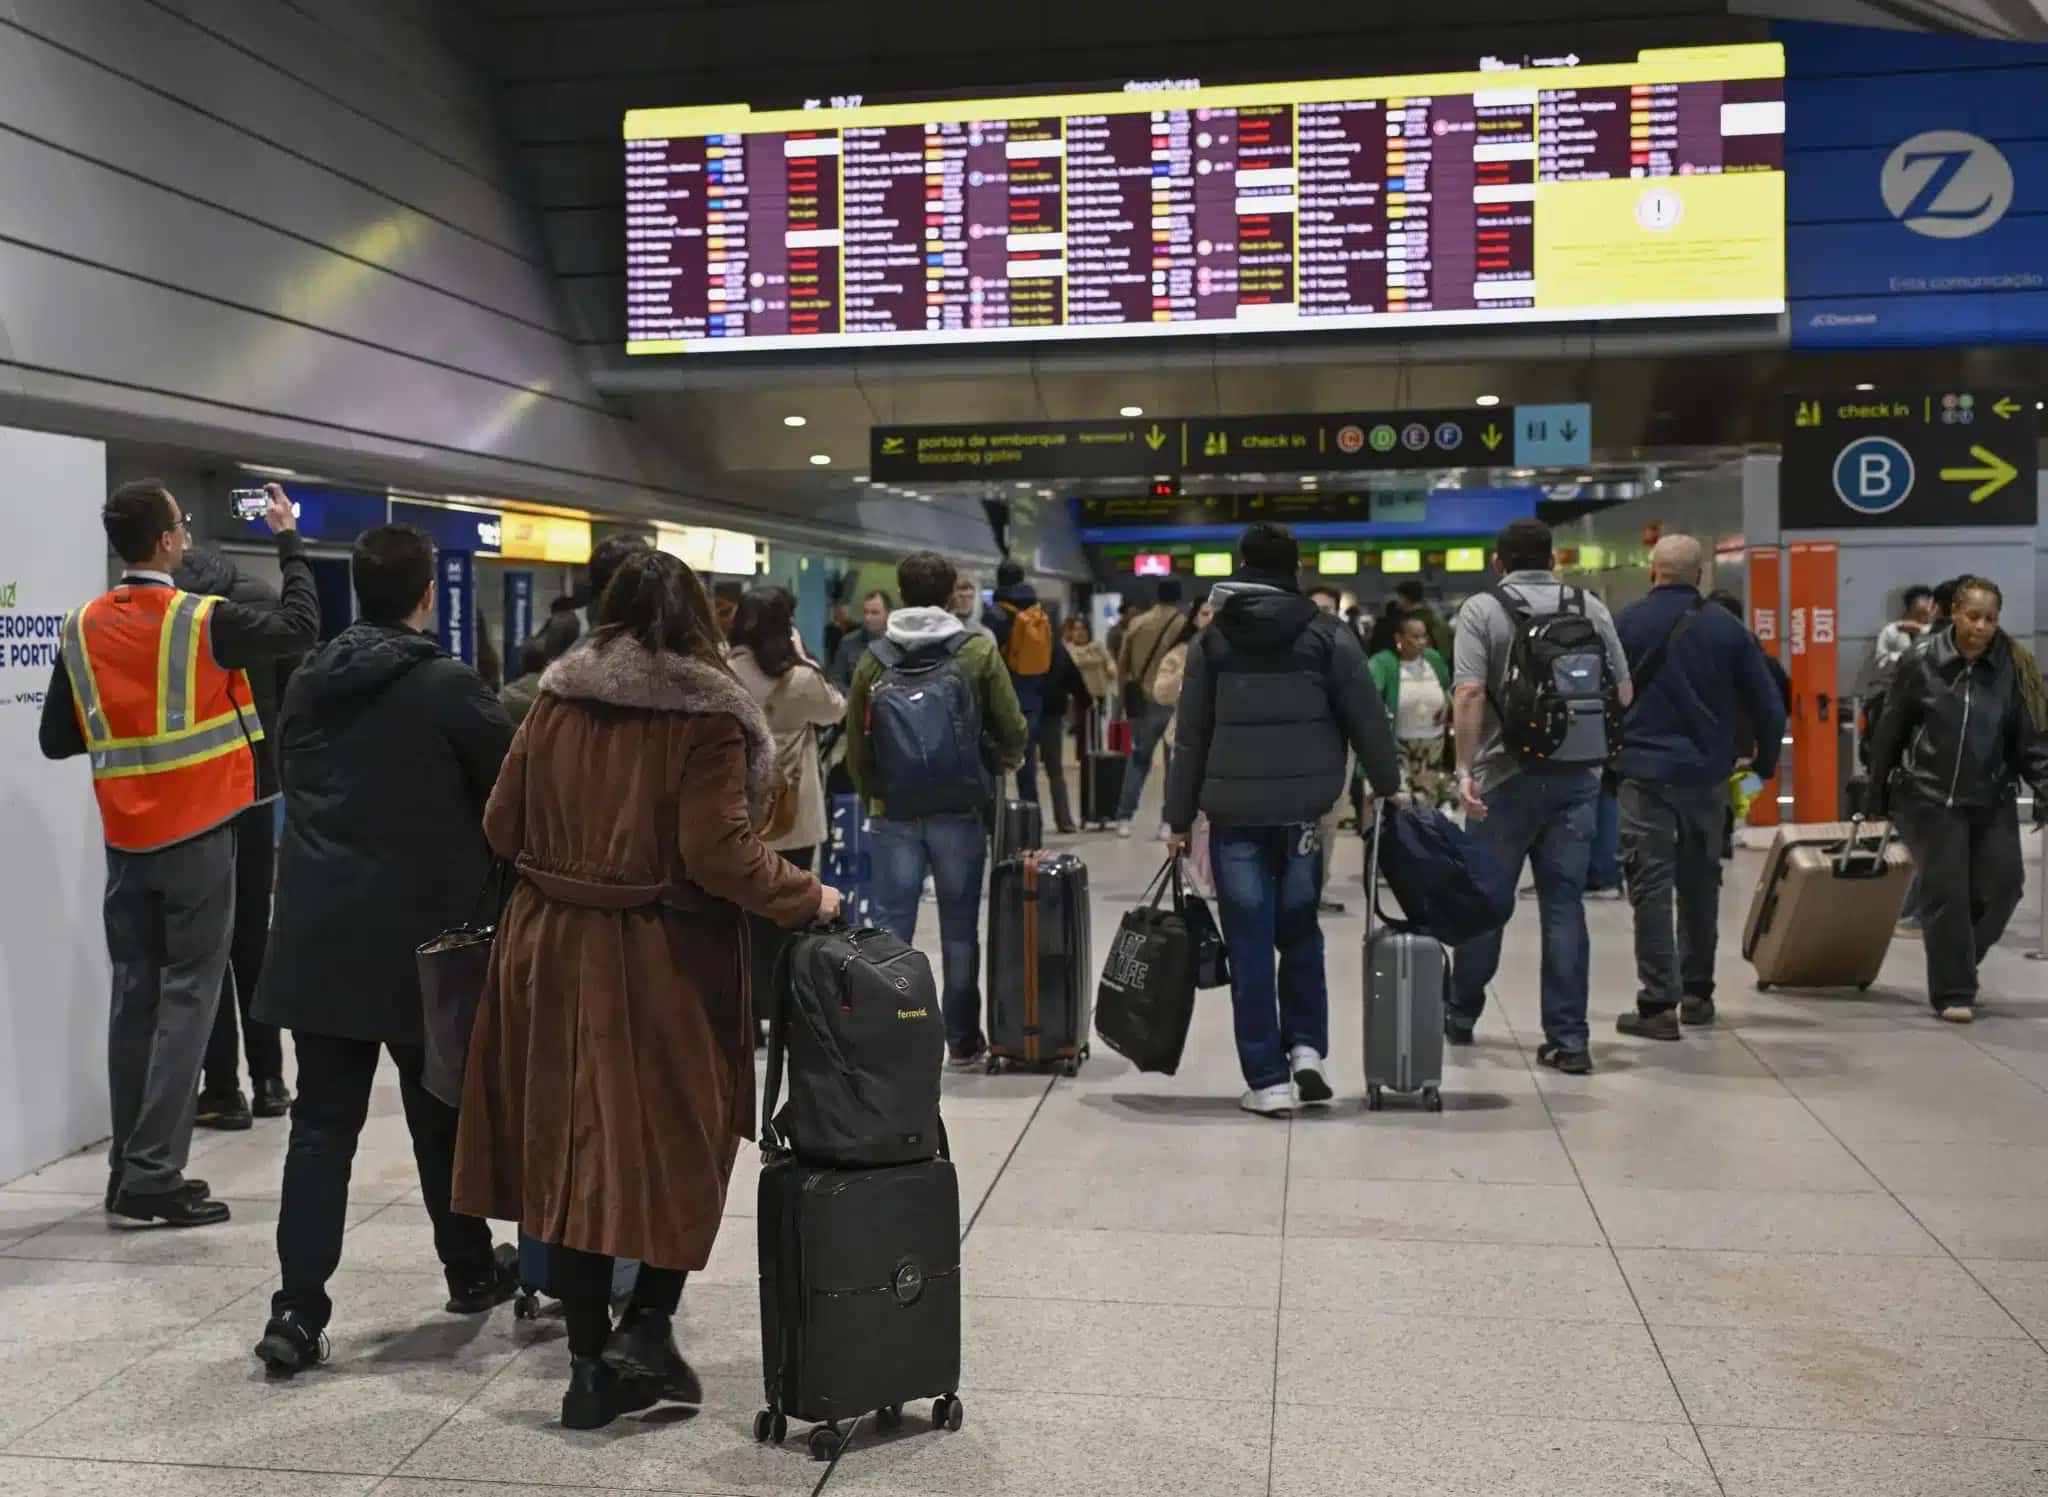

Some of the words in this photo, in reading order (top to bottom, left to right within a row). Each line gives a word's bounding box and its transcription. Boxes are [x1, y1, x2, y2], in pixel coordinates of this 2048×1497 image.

[1897, 150, 1994, 220] Z
[1838, 402, 1889, 419] check
[1894, 402, 1909, 416] in
[970, 434, 986, 447] de
[990, 433, 1066, 448] embarque
[1242, 432, 1287, 448] check
[1292, 431, 1306, 446] in
[1410, 429, 1422, 445] E
[1444, 428, 1456, 443] F
[1859, 454, 1892, 497] B
[1812, 607, 1834, 643] EXIT
